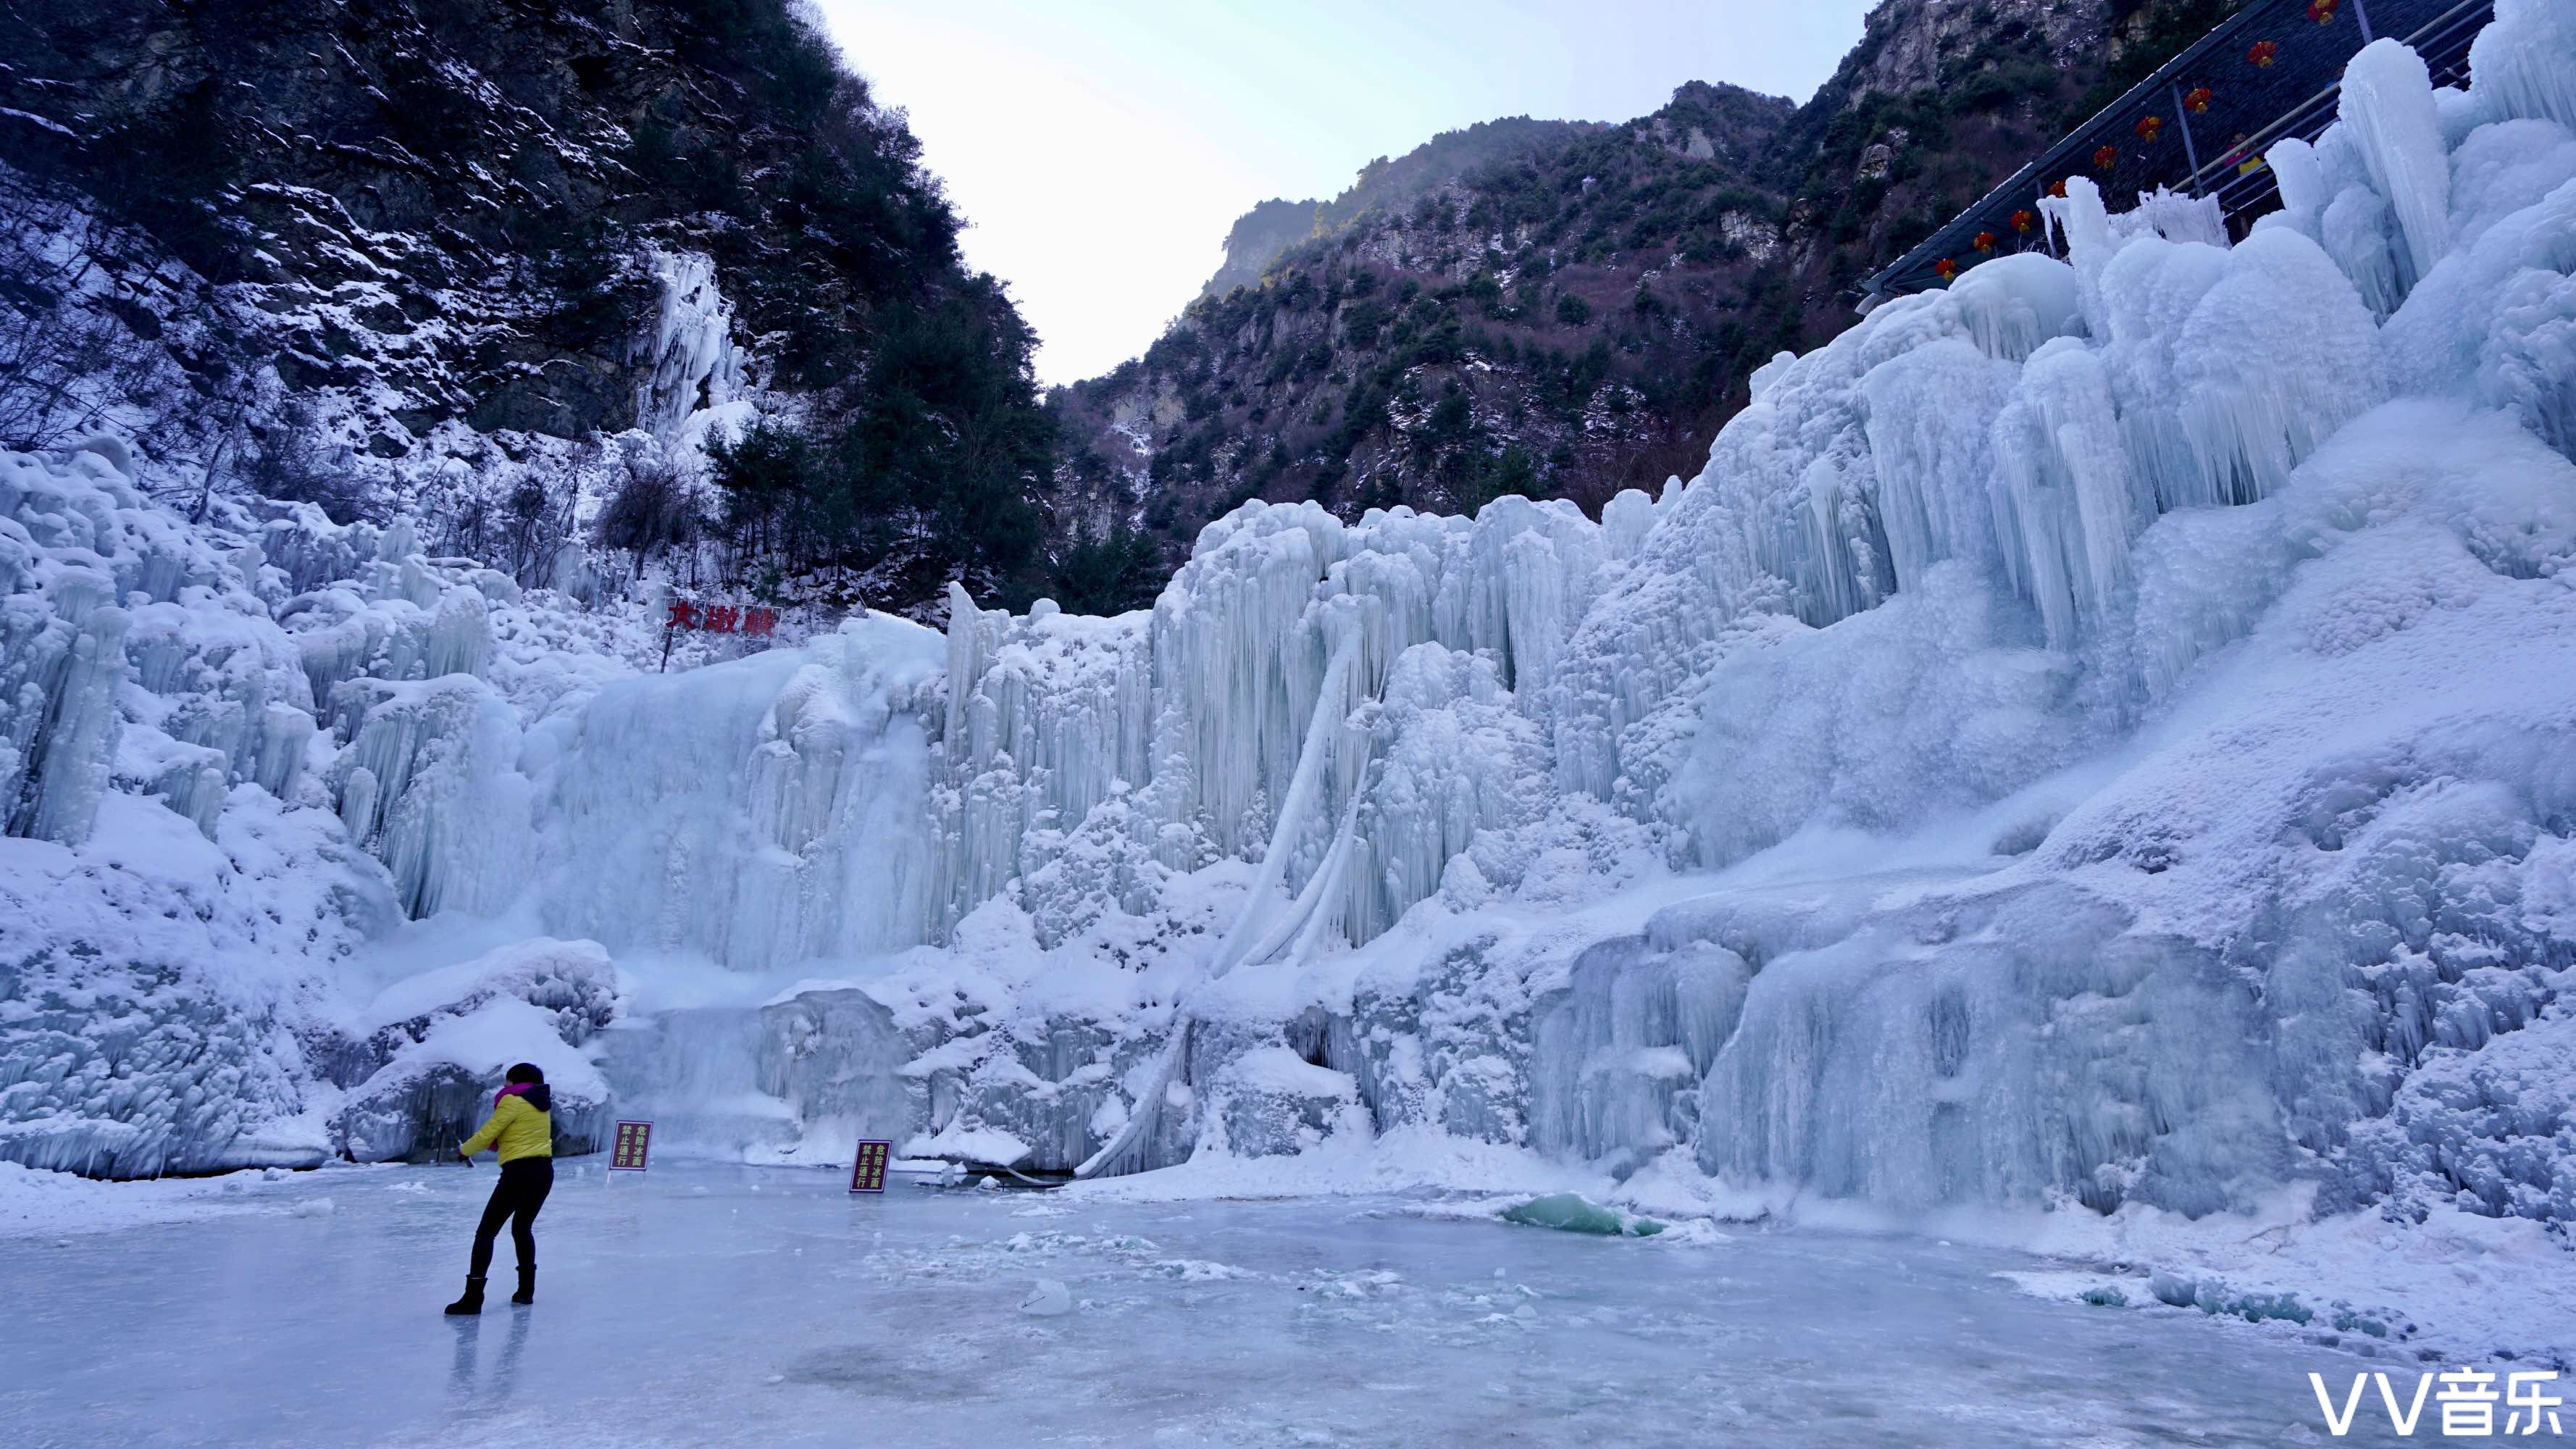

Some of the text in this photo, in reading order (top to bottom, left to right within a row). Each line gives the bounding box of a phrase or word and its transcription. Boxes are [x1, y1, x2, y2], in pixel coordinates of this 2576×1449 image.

[617, 1124, 632, 1166] 禁止通行
[632, 1126, 647, 1166] 危险冰面
[857, 1145, 871, 1187] 禁止通行
[870, 1145, 885, 1187] 危险冰面
